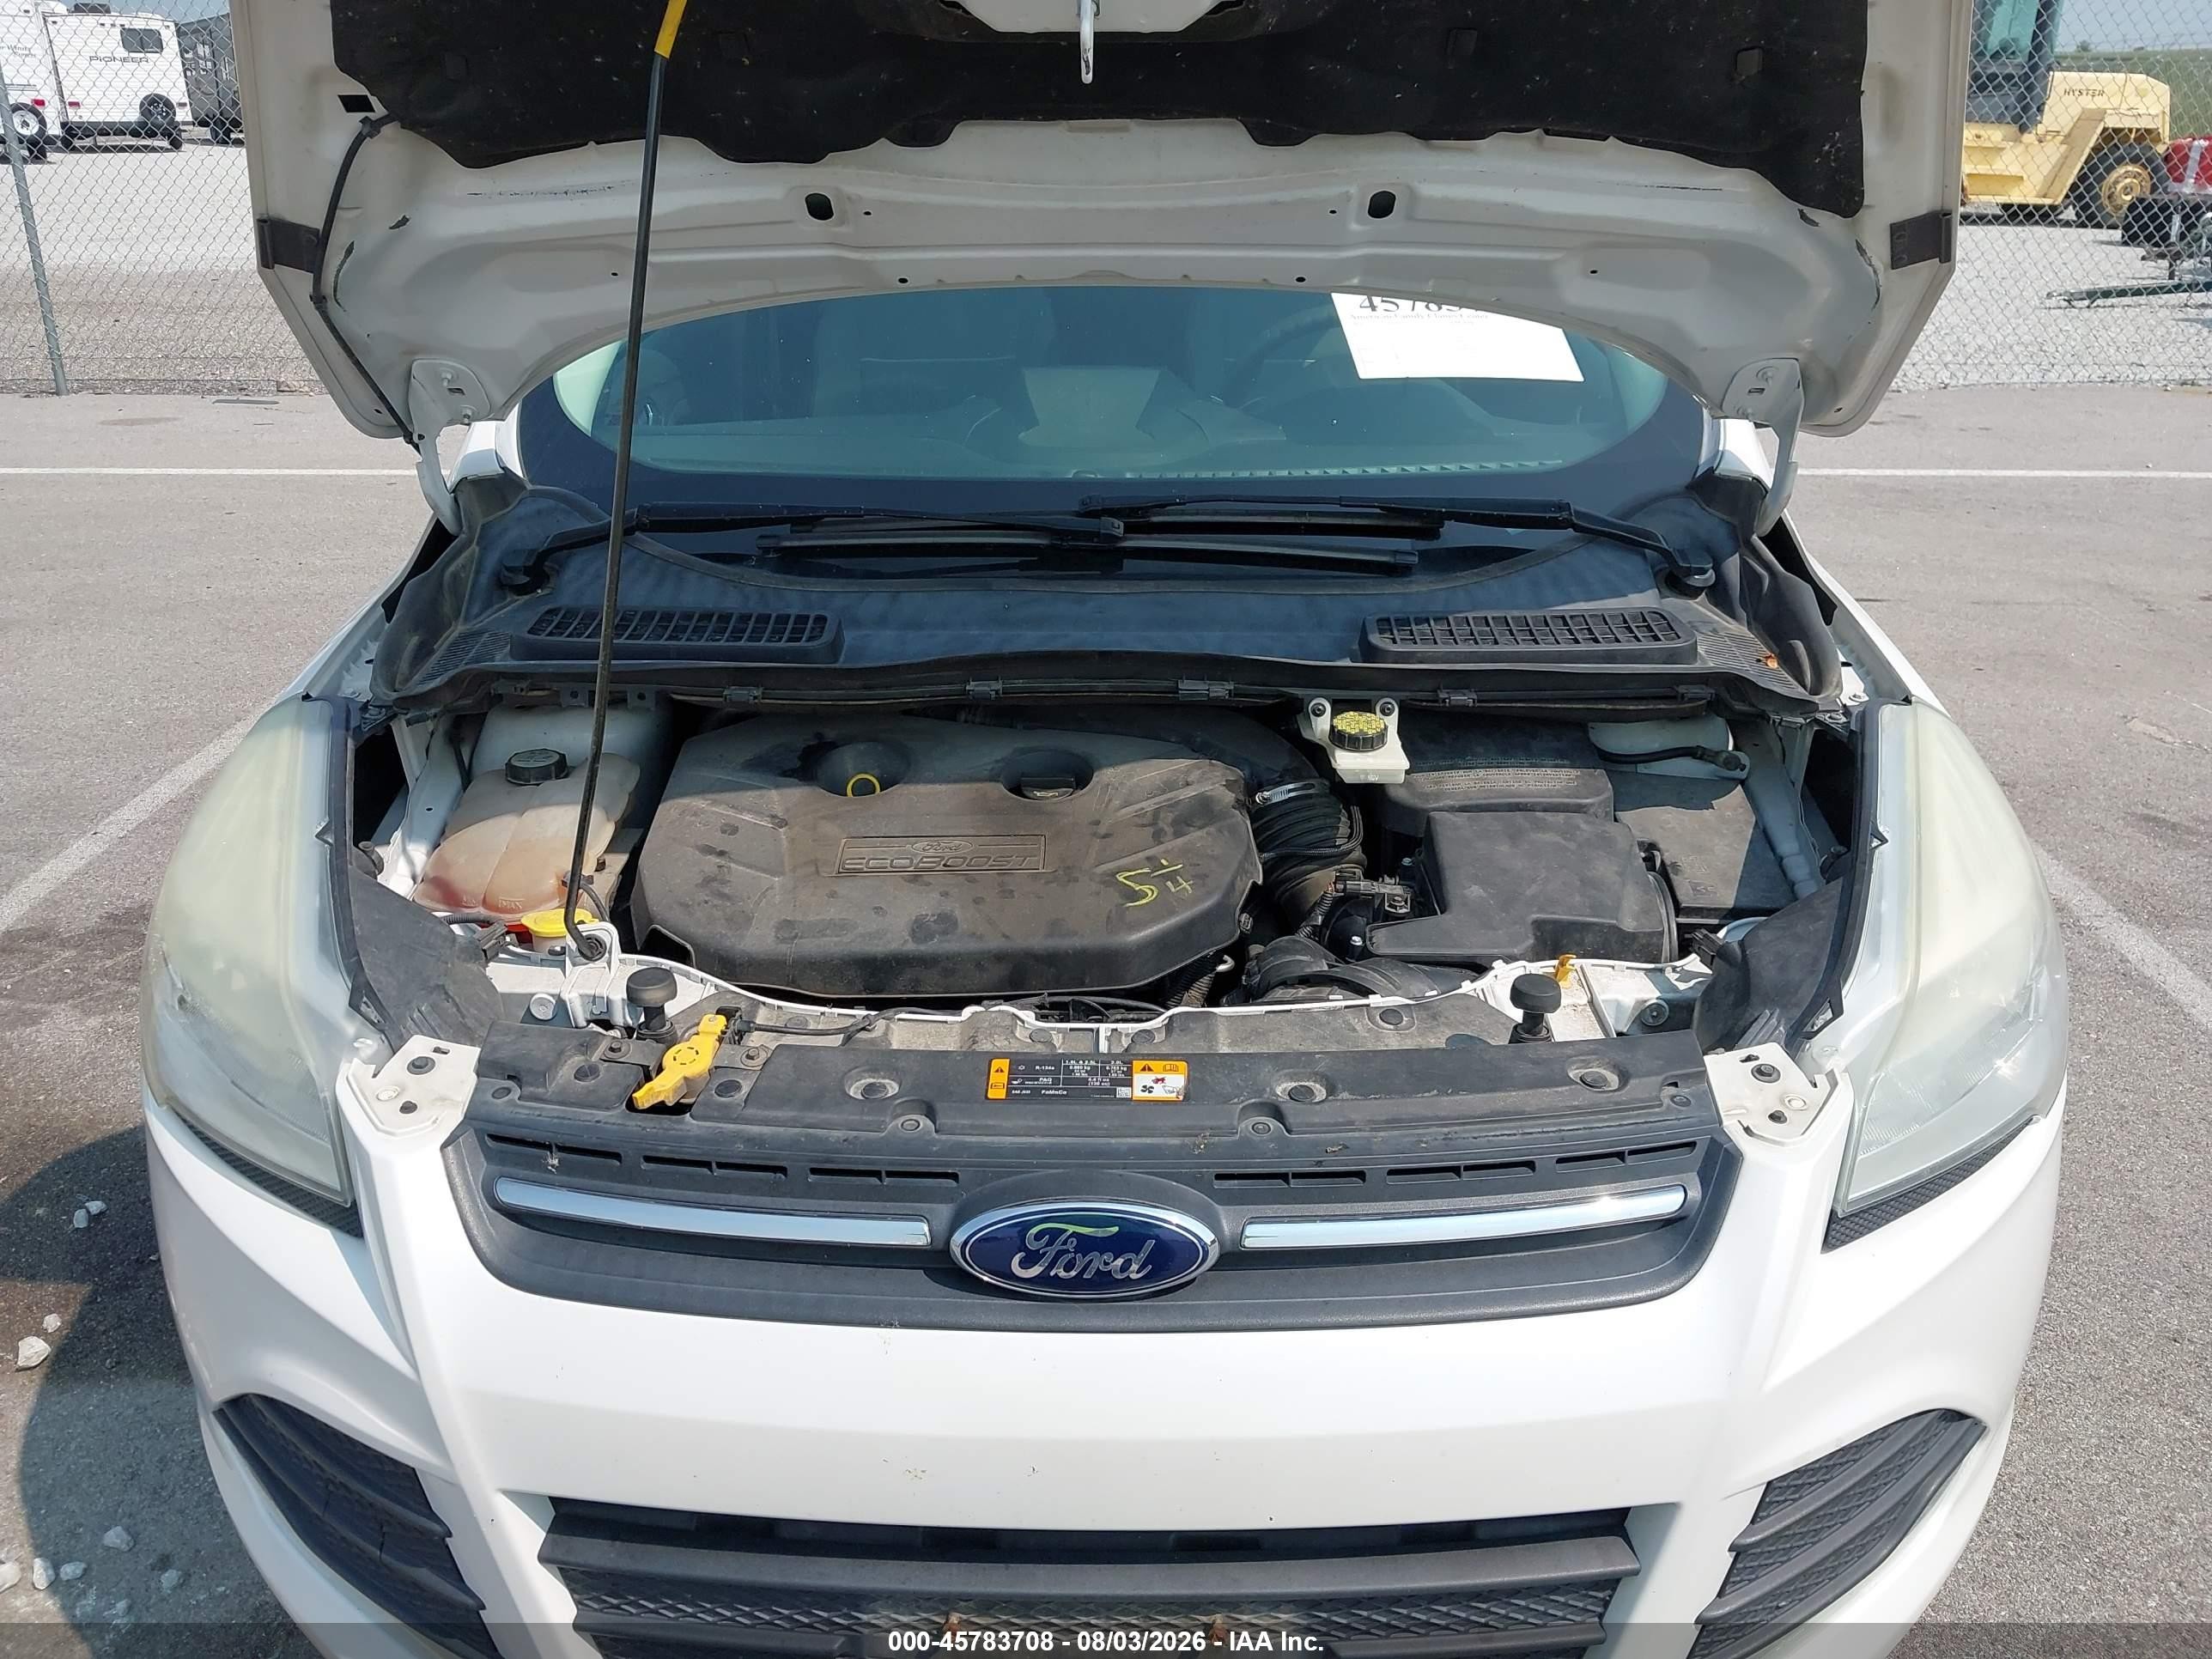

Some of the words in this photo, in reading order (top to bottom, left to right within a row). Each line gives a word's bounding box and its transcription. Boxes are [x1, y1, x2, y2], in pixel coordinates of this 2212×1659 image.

[2063, 88, 2105, 97] HYSTER
[922, 841, 963, 852] Ford
[842, 854, 1036, 872] ECOBOOST
[1011, 1222, 1156, 1280] Ford
